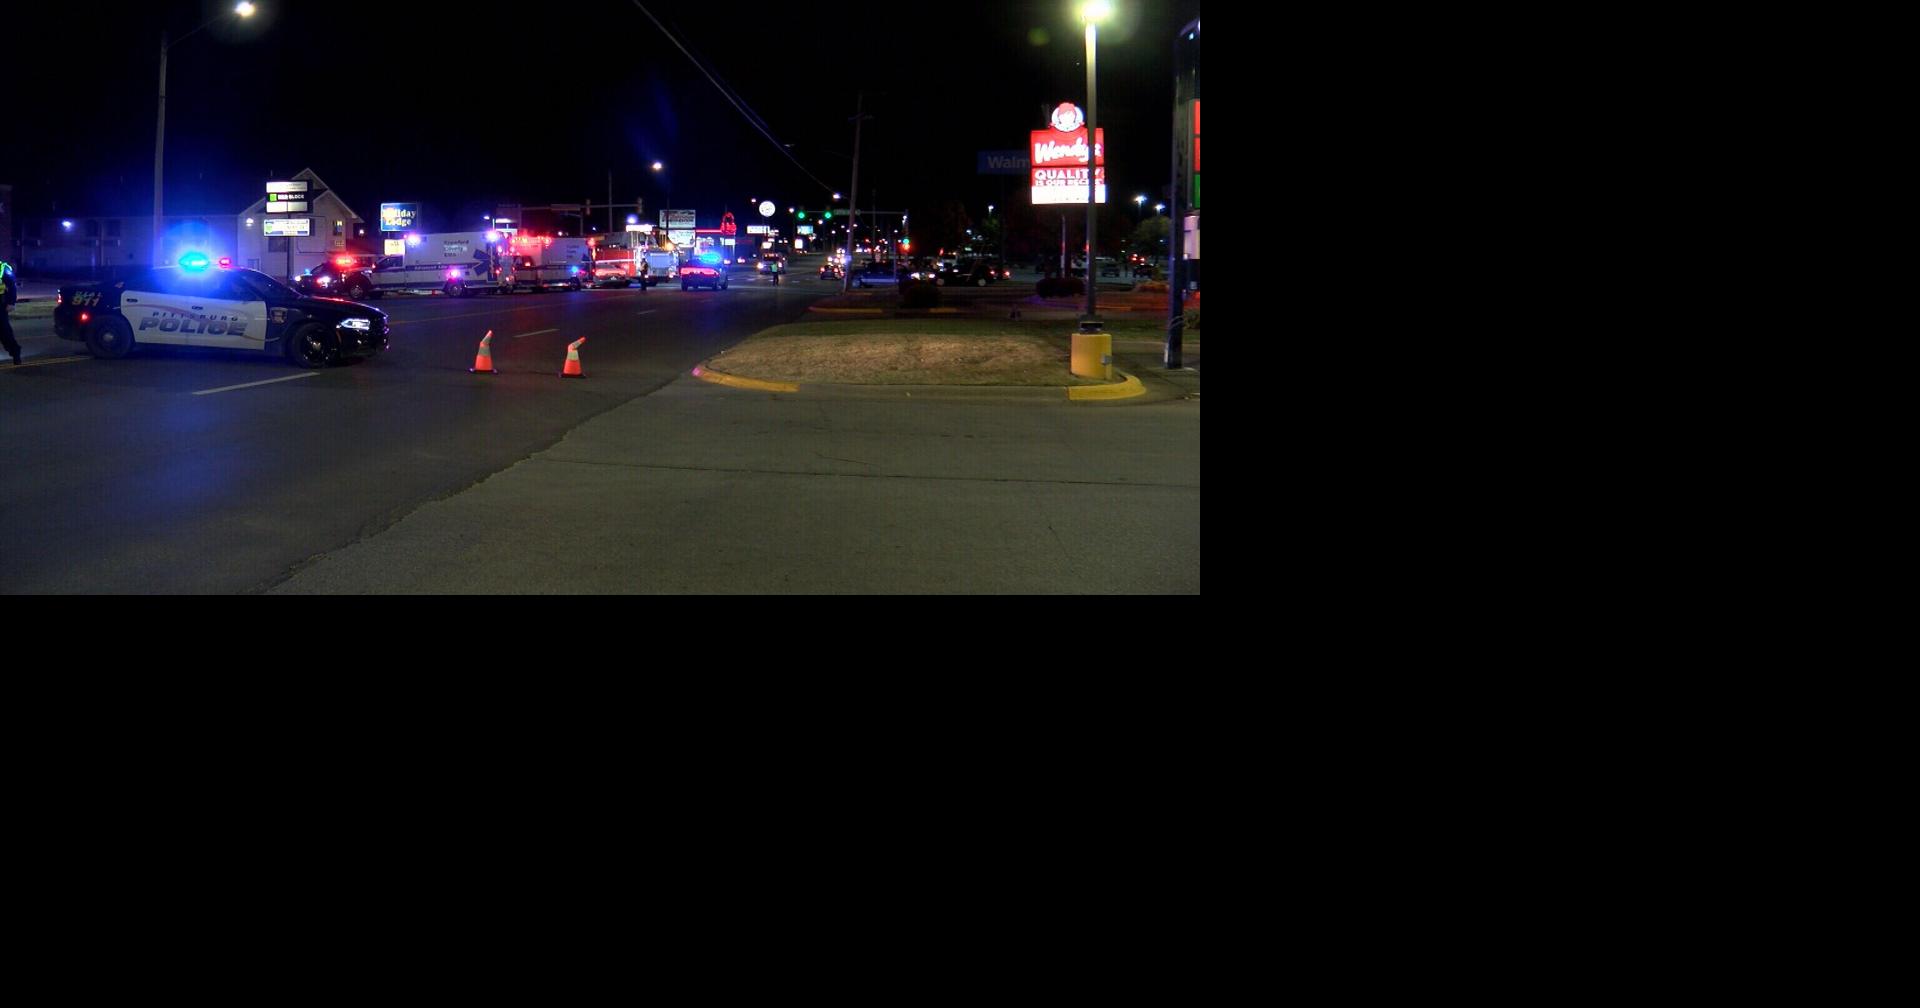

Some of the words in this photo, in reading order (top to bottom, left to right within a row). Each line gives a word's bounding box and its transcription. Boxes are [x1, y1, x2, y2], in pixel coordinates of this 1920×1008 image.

[1035, 137, 1102, 164] Wendys
[382, 208, 416, 219] liday
[152, 312, 239, 321] PITTSBURG
[139, 316, 248, 337] POLICE
